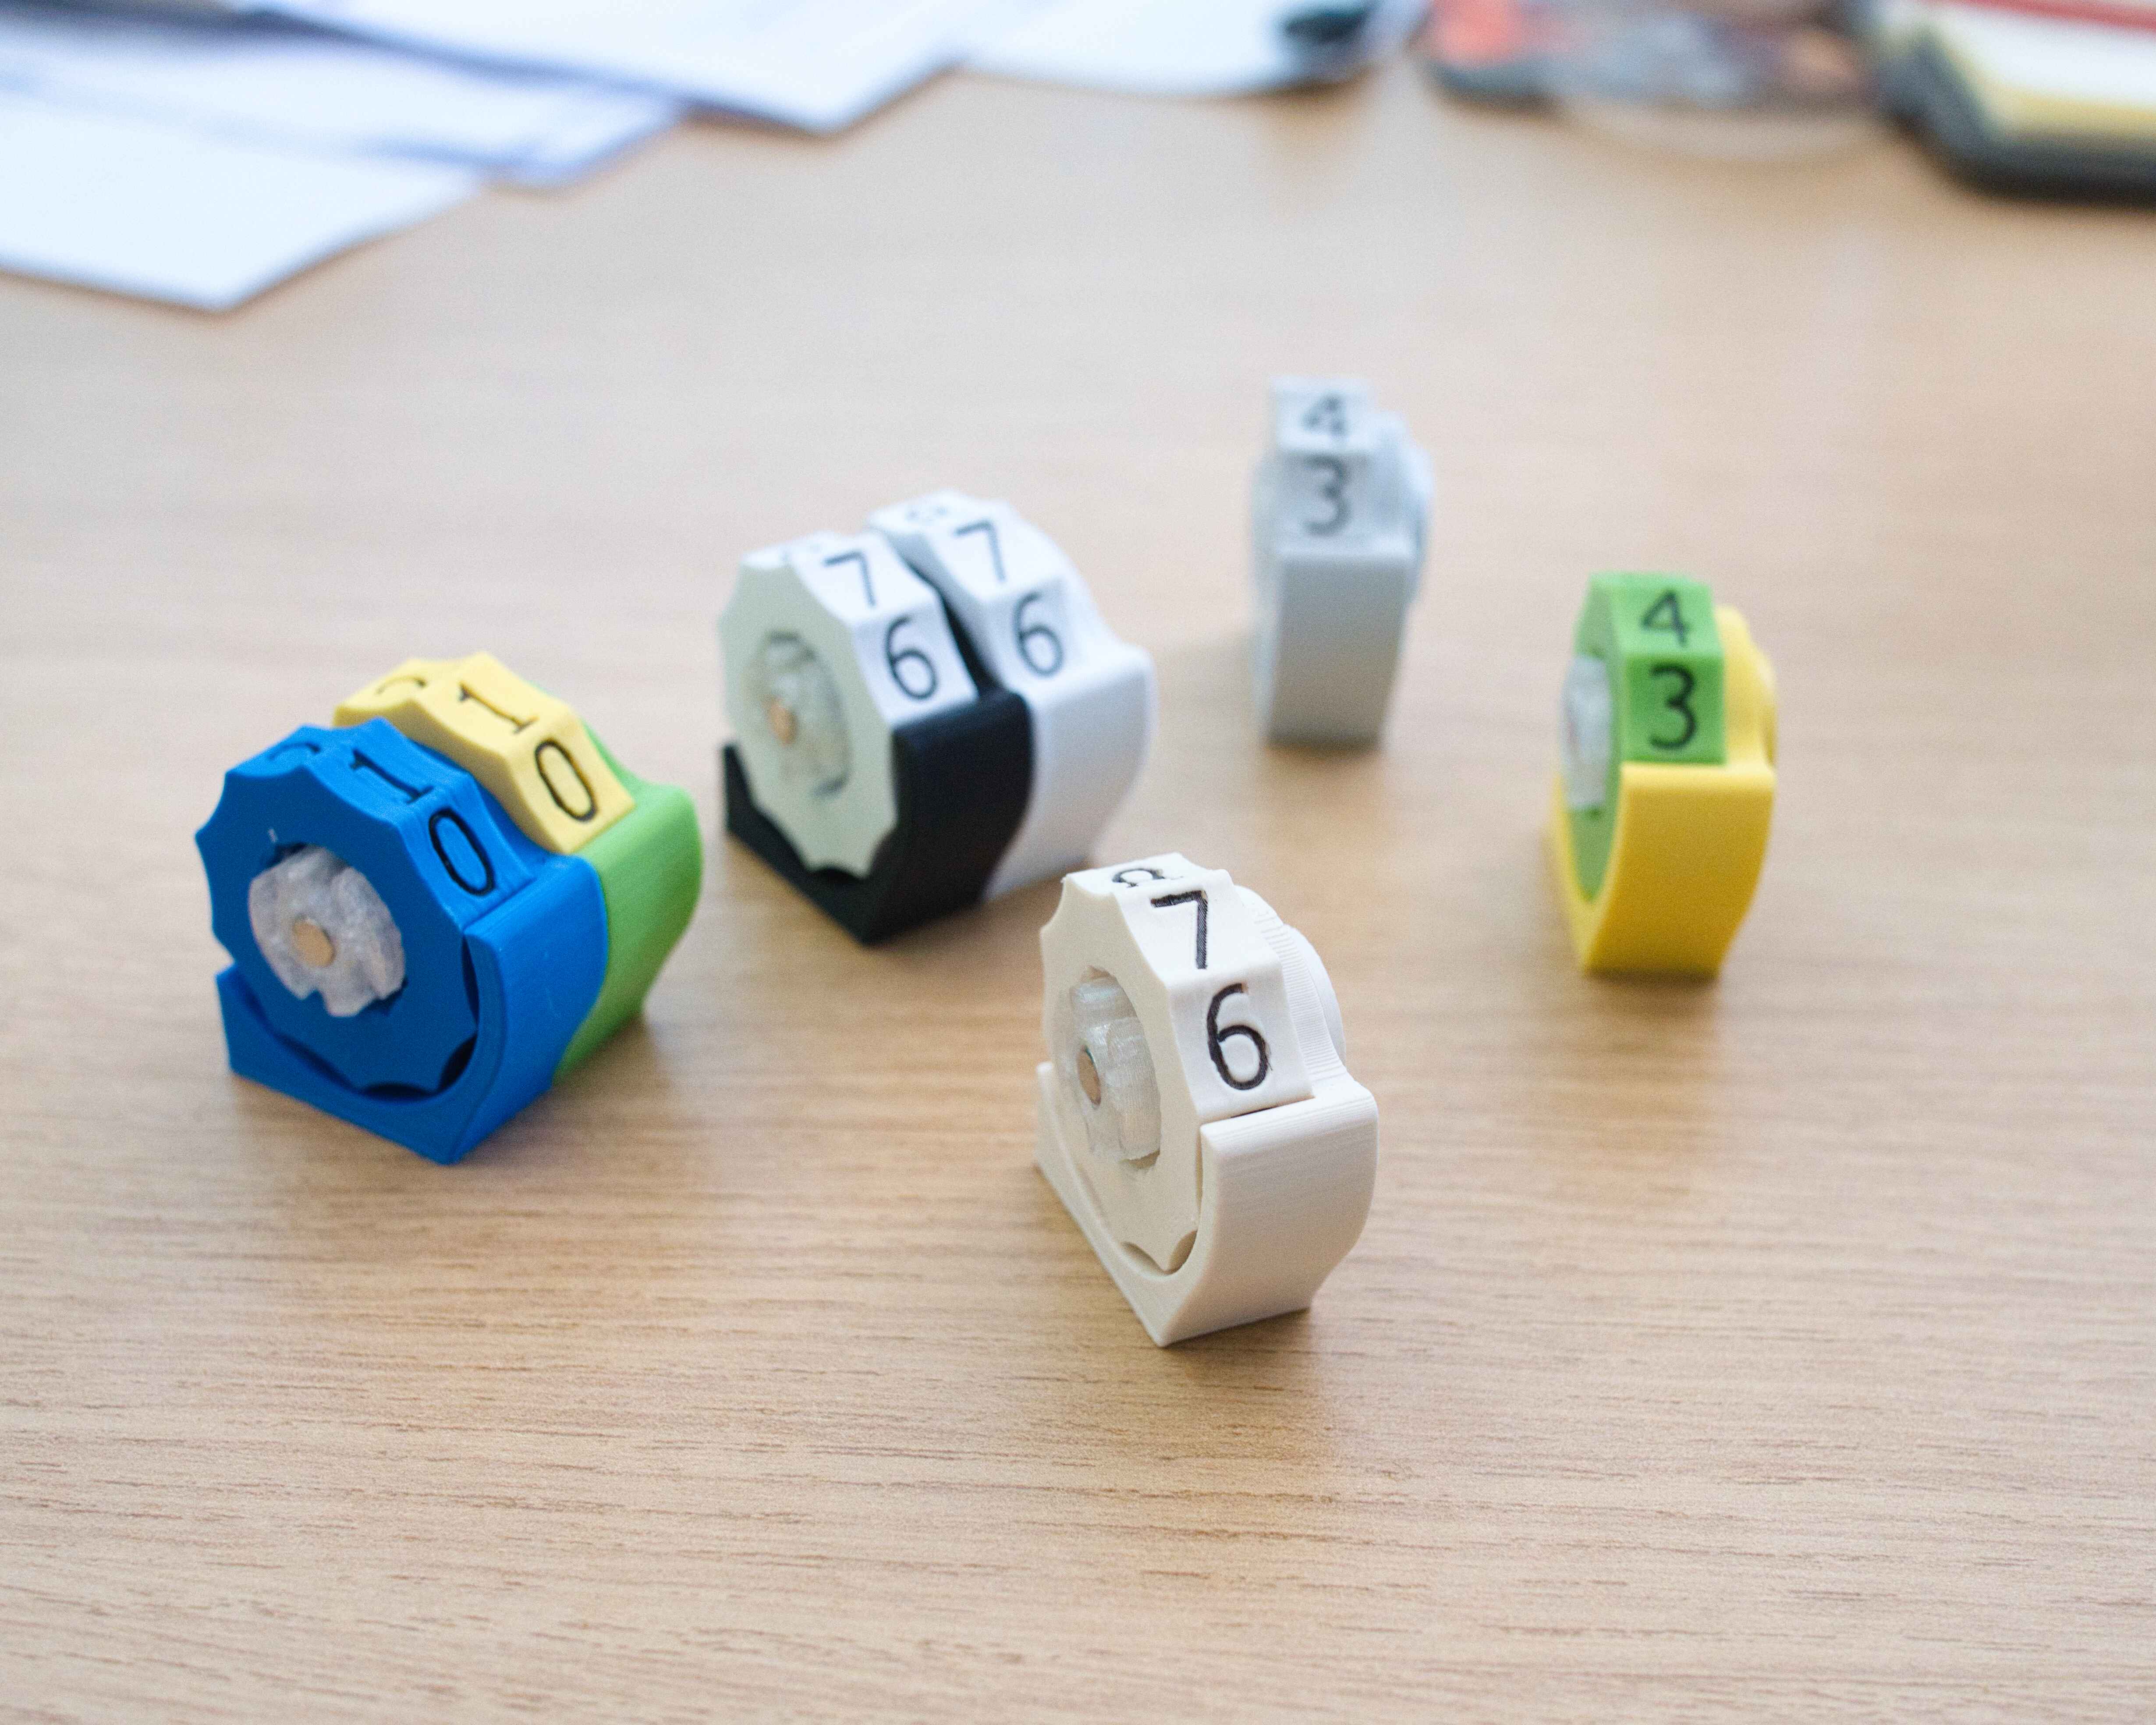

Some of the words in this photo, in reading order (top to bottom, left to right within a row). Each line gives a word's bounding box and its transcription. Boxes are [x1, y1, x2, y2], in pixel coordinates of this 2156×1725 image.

[1302, 394, 1348, 440] 4
[1303, 454, 1350, 537] 3
[823, 551, 876, 606] 7
[954, 519, 1005, 581] 7
[885, 615, 937, 700] 6
[1013, 592, 1064, 676] 6
[1640, 589, 1690, 647] 4
[459, 682, 538, 734] 1
[1650, 662, 1698, 750] 3
[350, 749, 434, 803] 1
[535, 739, 599, 822] 0
[428, 809, 495, 895] 0
[1151, 890, 1208, 969] 7
[1207, 983, 1270, 1090] 6
